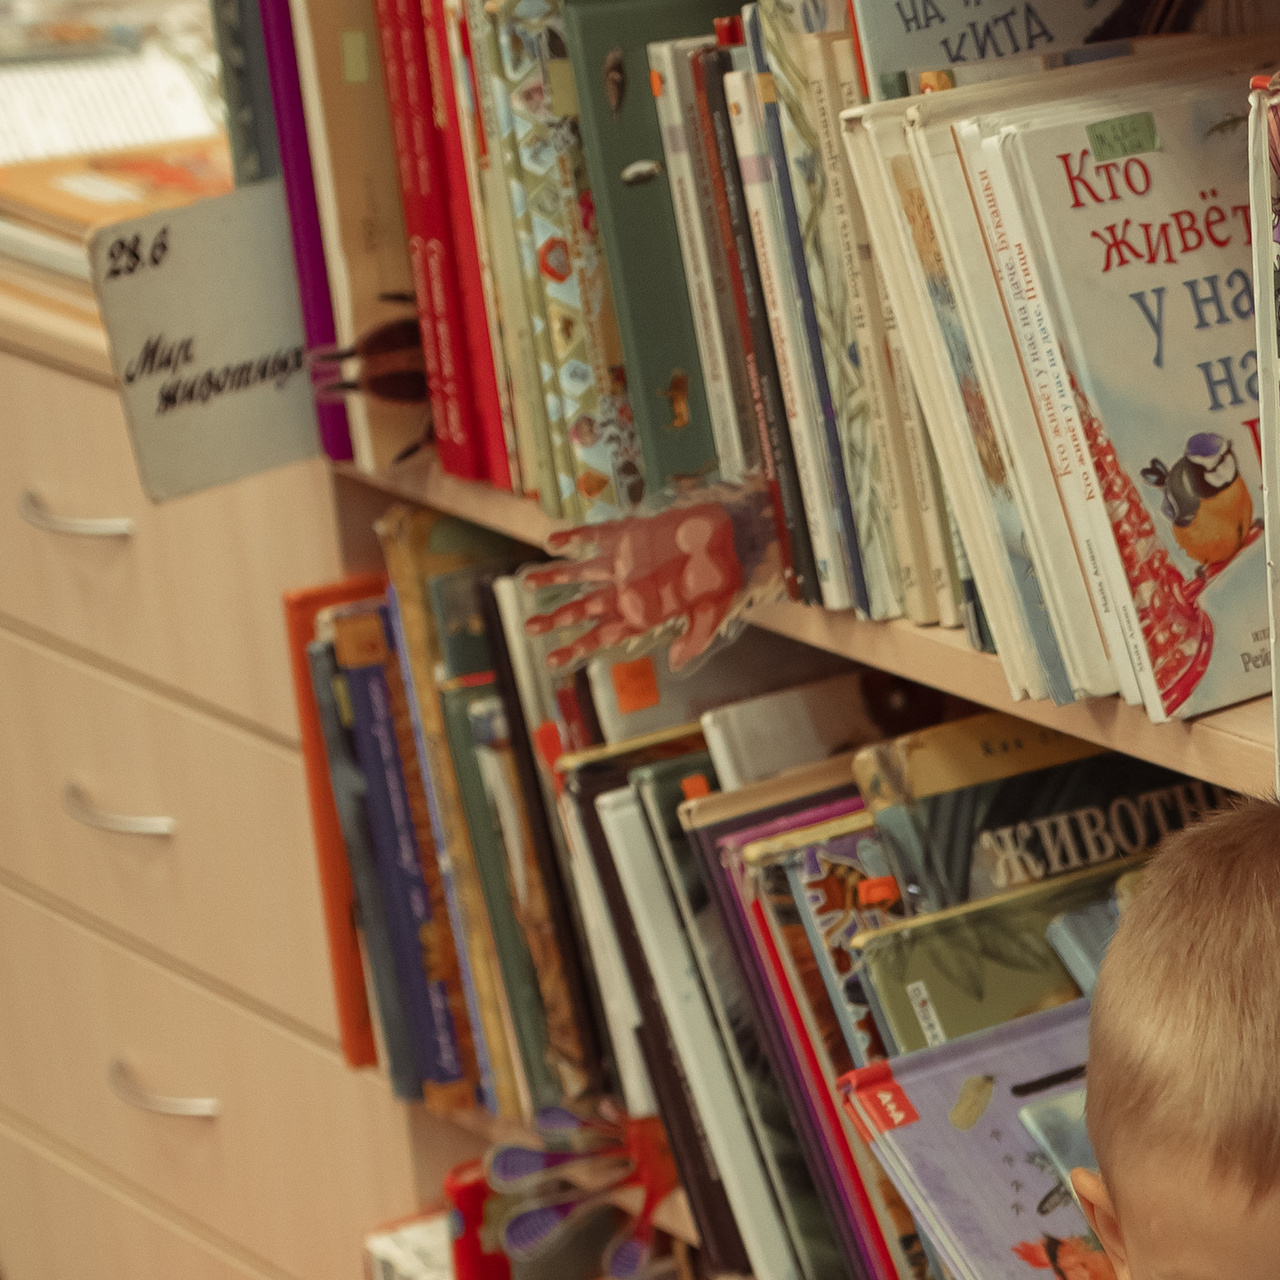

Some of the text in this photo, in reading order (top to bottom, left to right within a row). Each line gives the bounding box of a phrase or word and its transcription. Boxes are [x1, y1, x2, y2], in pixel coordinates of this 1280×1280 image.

[940, 3, 1054, 64] КИТА
[1056, 149, 1151, 208] Кто
[1128, 287, 1167, 369] у
